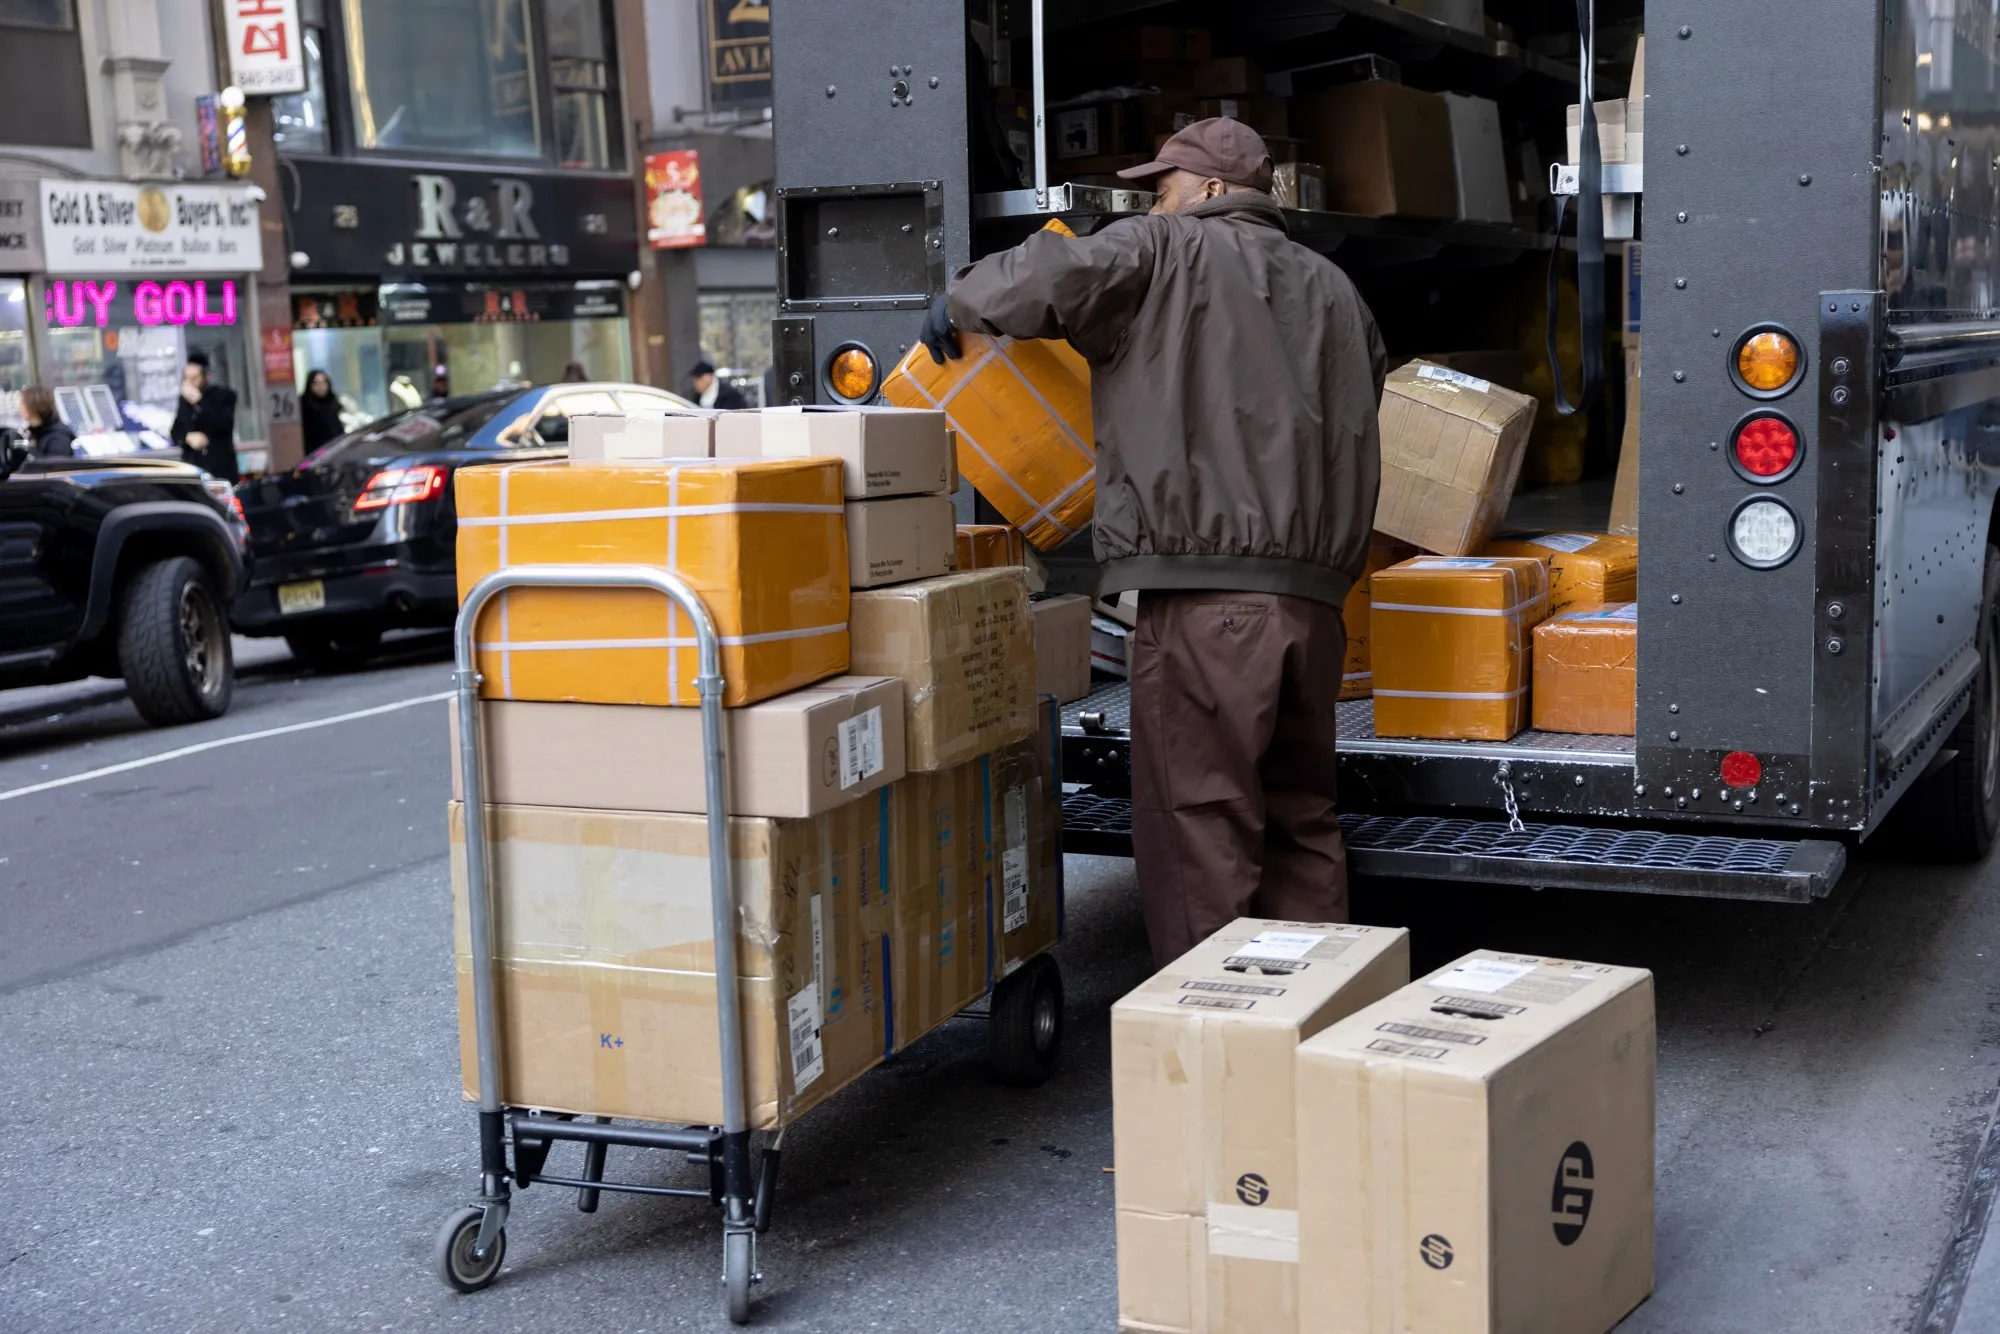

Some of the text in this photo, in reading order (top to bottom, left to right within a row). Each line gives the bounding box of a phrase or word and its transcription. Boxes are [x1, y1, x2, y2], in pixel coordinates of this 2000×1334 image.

[49, 191, 80, 225] Gold
[84, 192, 93, 225] &
[97, 192, 134, 225] Silver
[387, 243, 570, 267] JEWELERS
[46, 280, 117, 327] UY
[270, 392, 294, 418] 26
[600, 1033, 624, 1050] K+
[1236, 1173, 1269, 1206] hp
[1551, 1148, 1594, 1236] hp
[1420, 1235, 1454, 1270] hp
